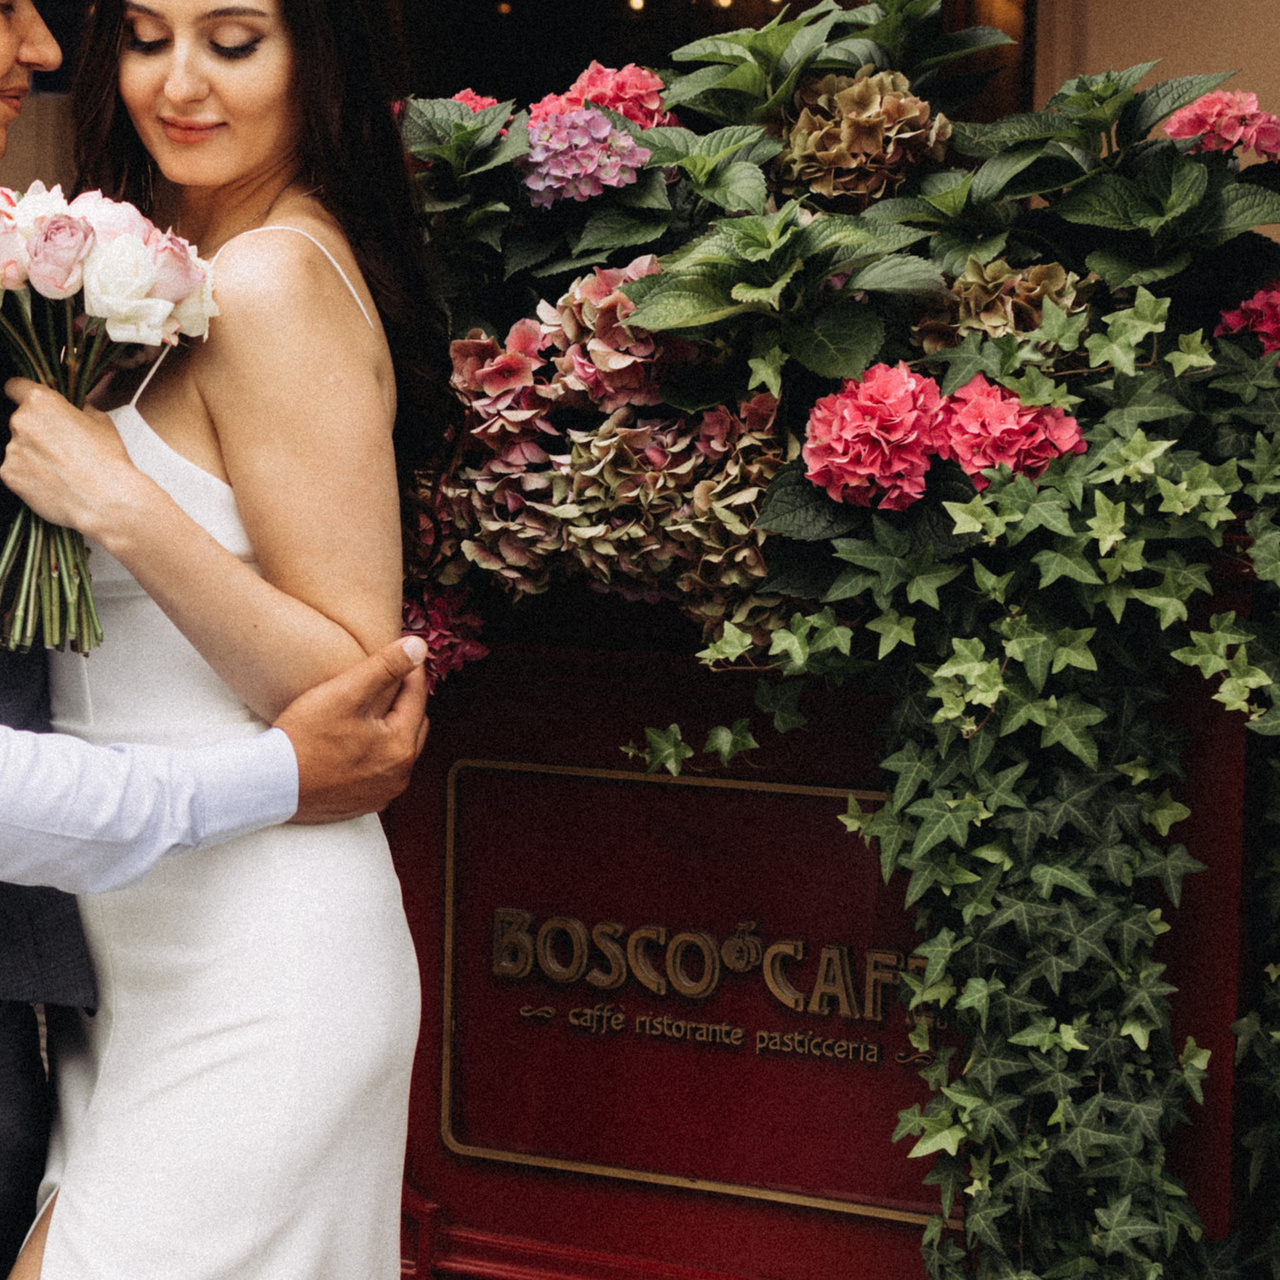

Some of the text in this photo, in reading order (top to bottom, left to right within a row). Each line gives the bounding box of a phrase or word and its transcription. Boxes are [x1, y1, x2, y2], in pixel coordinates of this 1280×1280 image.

[493, 907, 721, 999] BOSCO
[635, 1011, 745, 1047] ristorante
[755, 1029, 879, 1064] pasticceria
